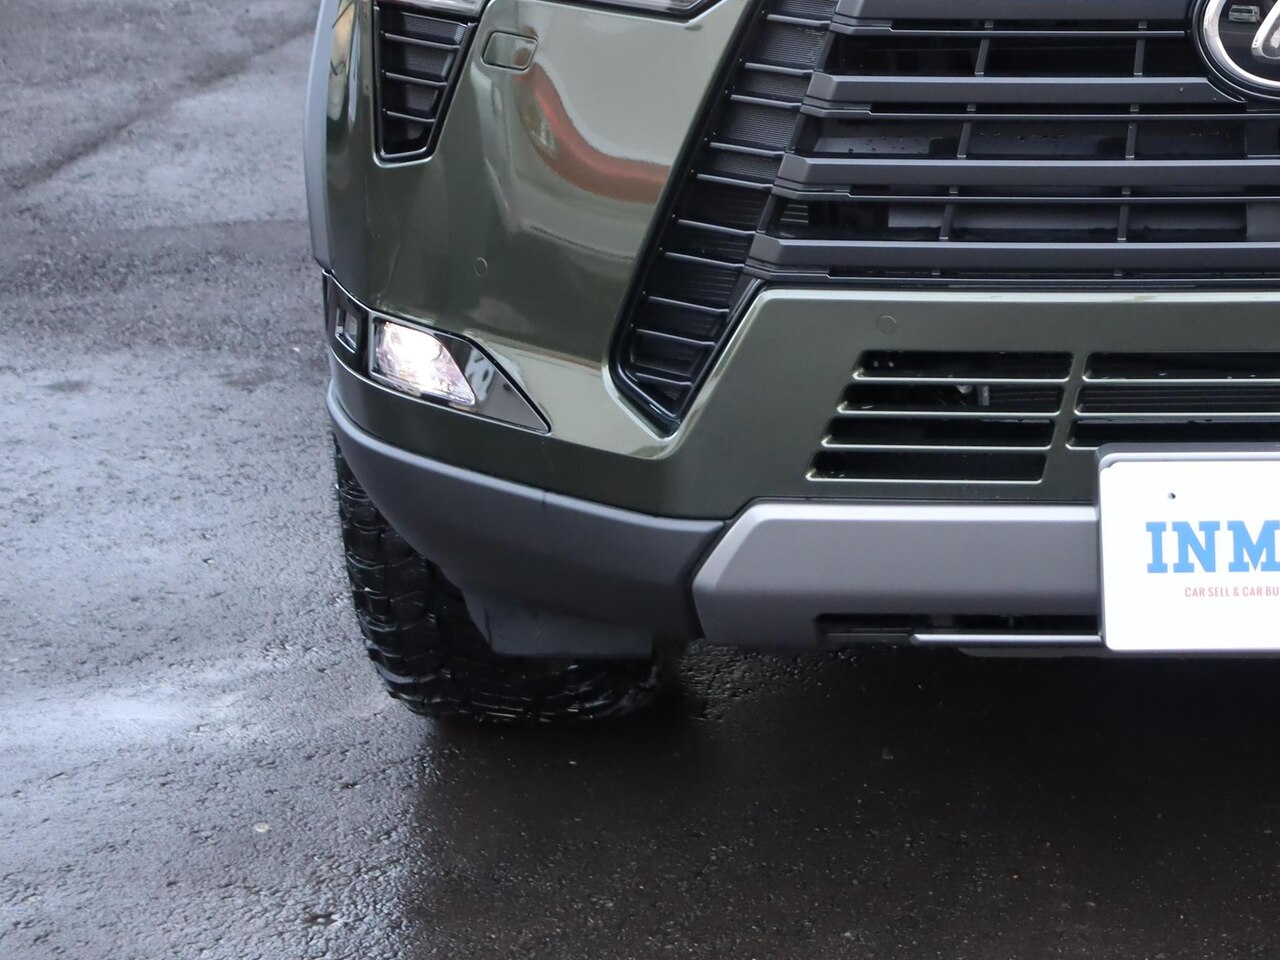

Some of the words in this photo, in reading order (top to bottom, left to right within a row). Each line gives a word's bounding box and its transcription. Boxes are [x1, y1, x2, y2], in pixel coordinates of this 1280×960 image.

[1184, 586, 1206, 598] CAR
[1207, 586, 1231, 598] SELL
[1232, 586, 1240, 598] &
[1241, 586, 1263, 597] CAR
